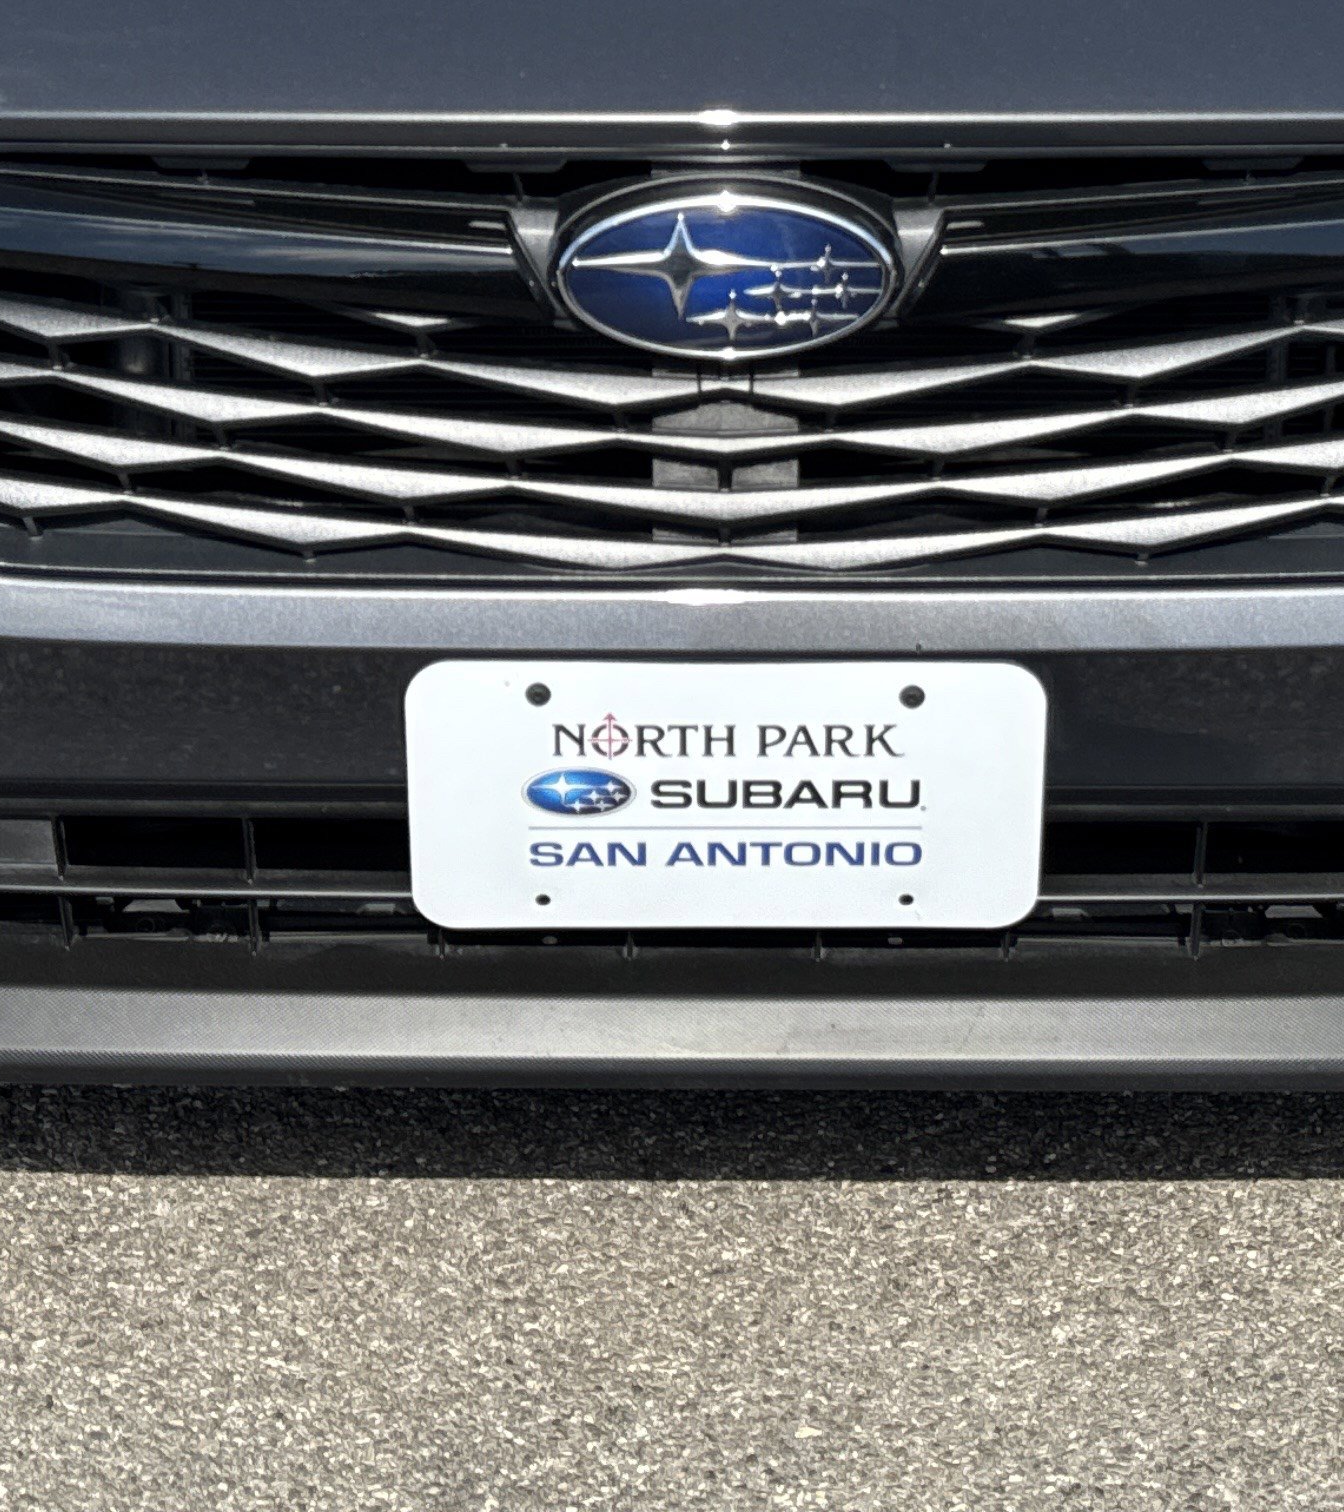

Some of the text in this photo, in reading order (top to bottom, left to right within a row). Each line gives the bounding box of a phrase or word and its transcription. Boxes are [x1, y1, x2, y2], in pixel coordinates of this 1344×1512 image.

[552, 722, 905, 758] NORTH PARK
[650, 779, 923, 809] SUBARU
[529, 841, 923, 867] SAN ANTONIO
